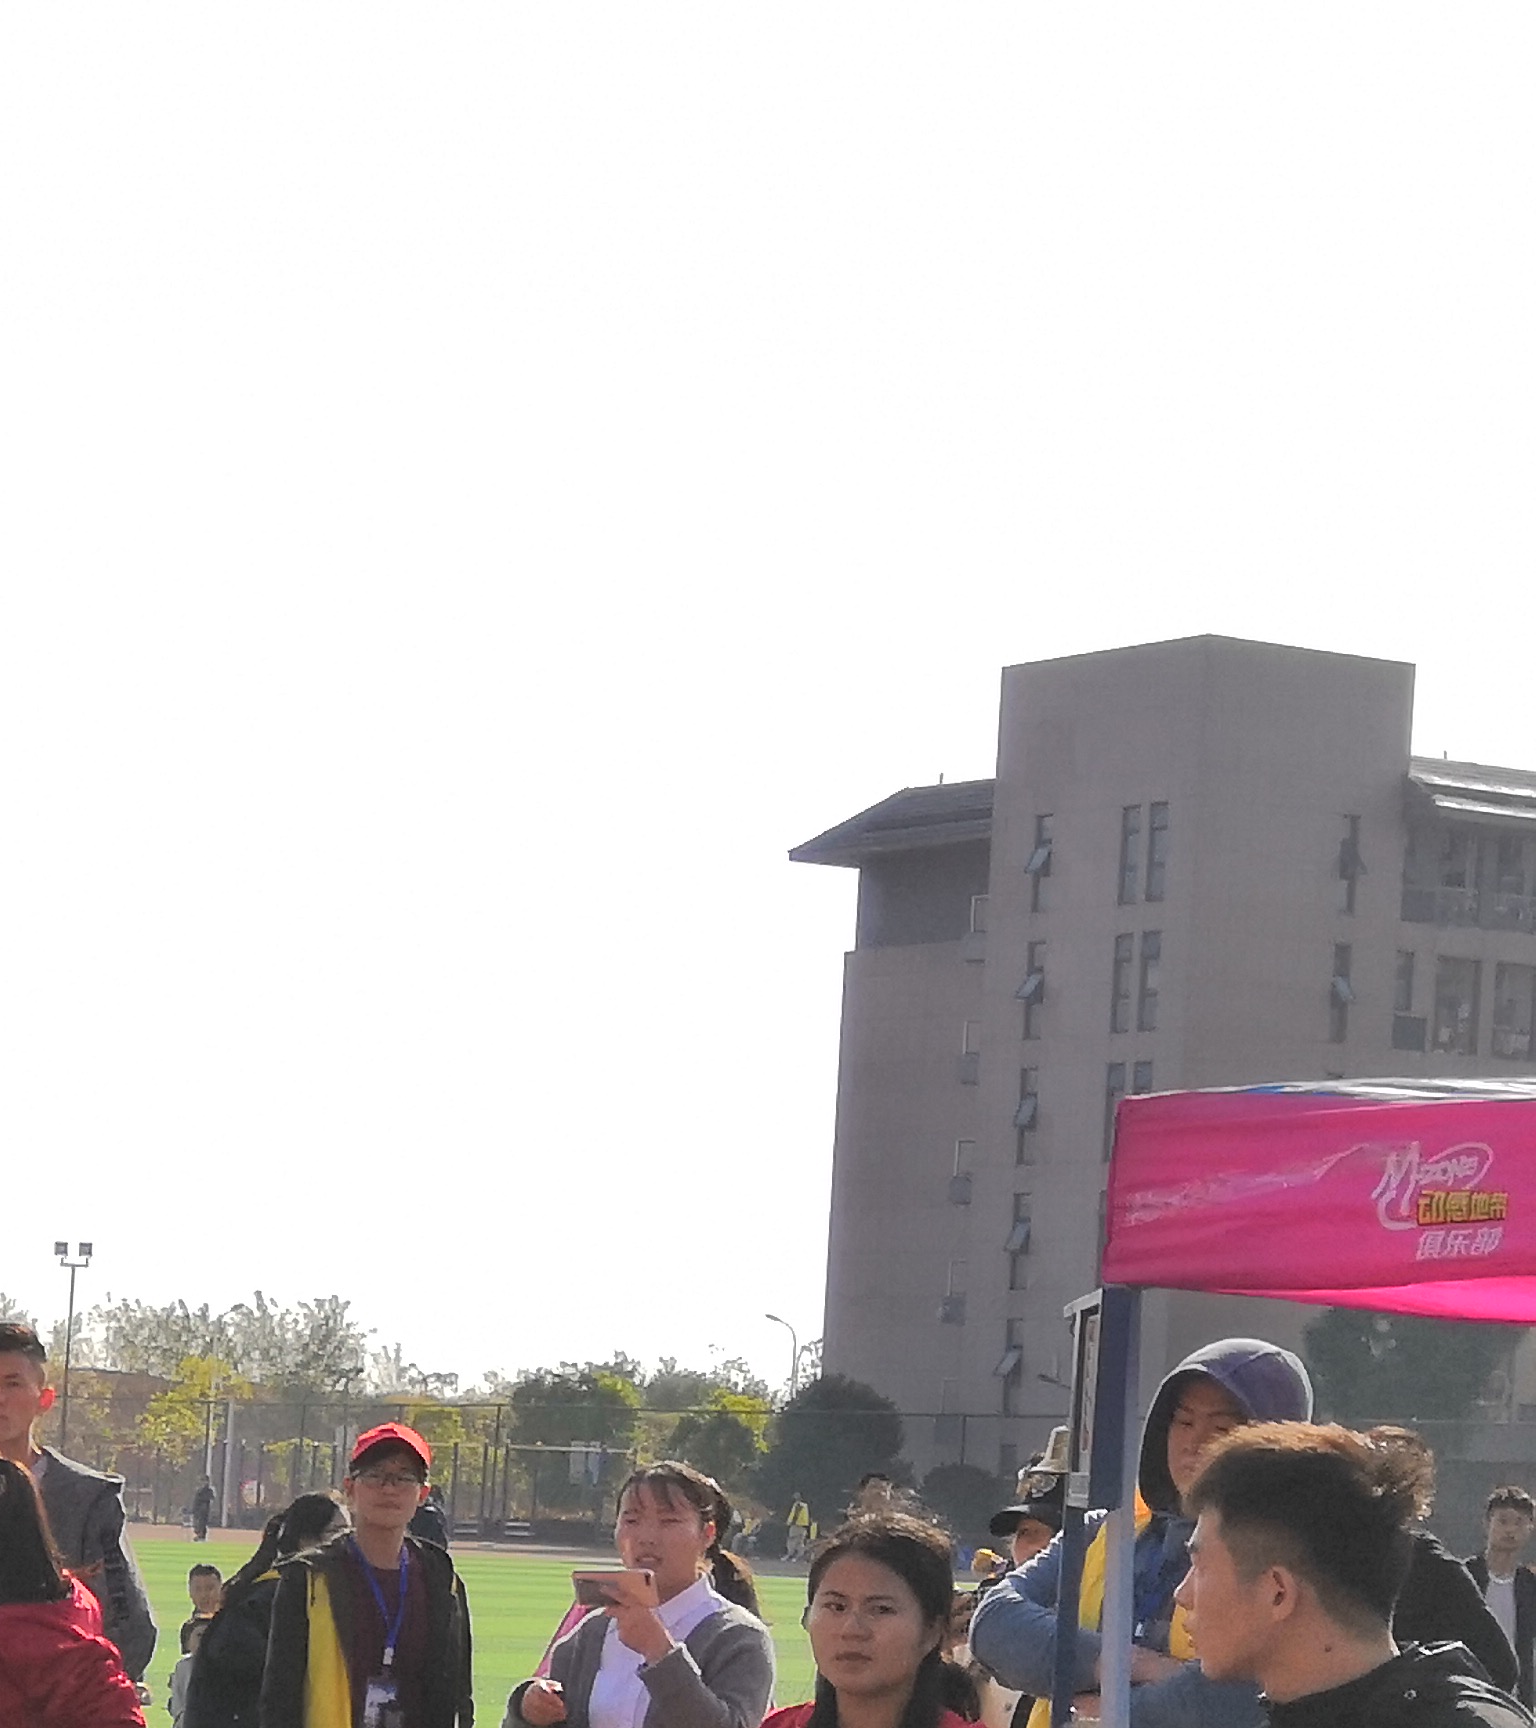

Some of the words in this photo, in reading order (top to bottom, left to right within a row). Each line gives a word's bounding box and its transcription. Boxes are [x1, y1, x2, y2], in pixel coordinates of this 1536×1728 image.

[1417, 1190, 1508, 1225] 动感地带
[1417, 1227, 1502, 1260] 俱乐部
